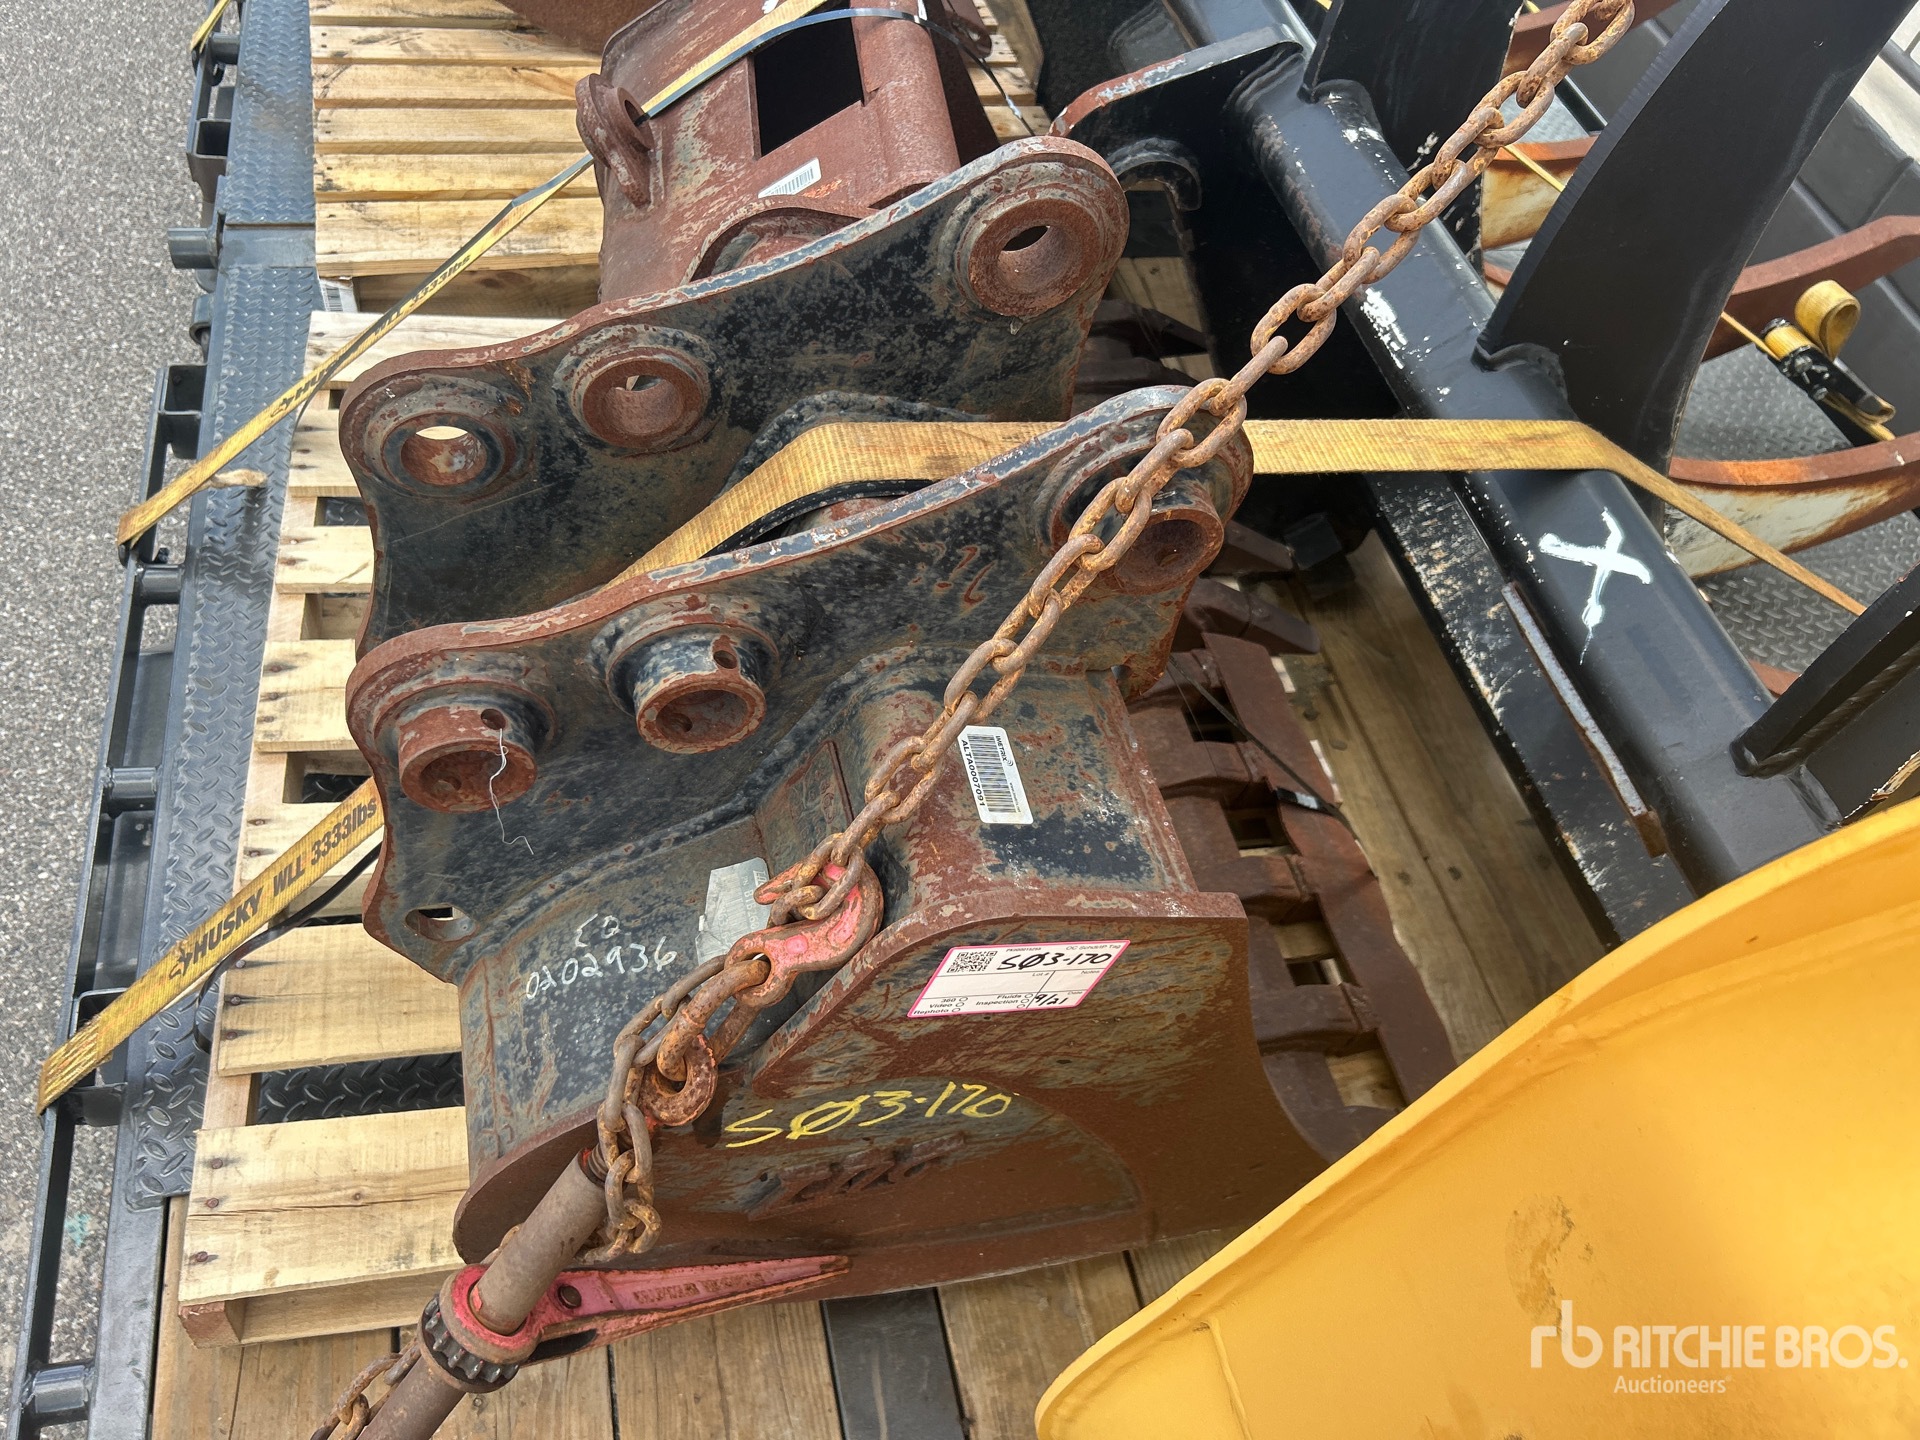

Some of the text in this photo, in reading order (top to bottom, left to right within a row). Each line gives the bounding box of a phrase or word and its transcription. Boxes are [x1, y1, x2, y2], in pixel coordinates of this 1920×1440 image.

[961, 739, 986, 807] ALTA0007091
[192, 798, 378, 965] HUSKY WLL 3333lbs
